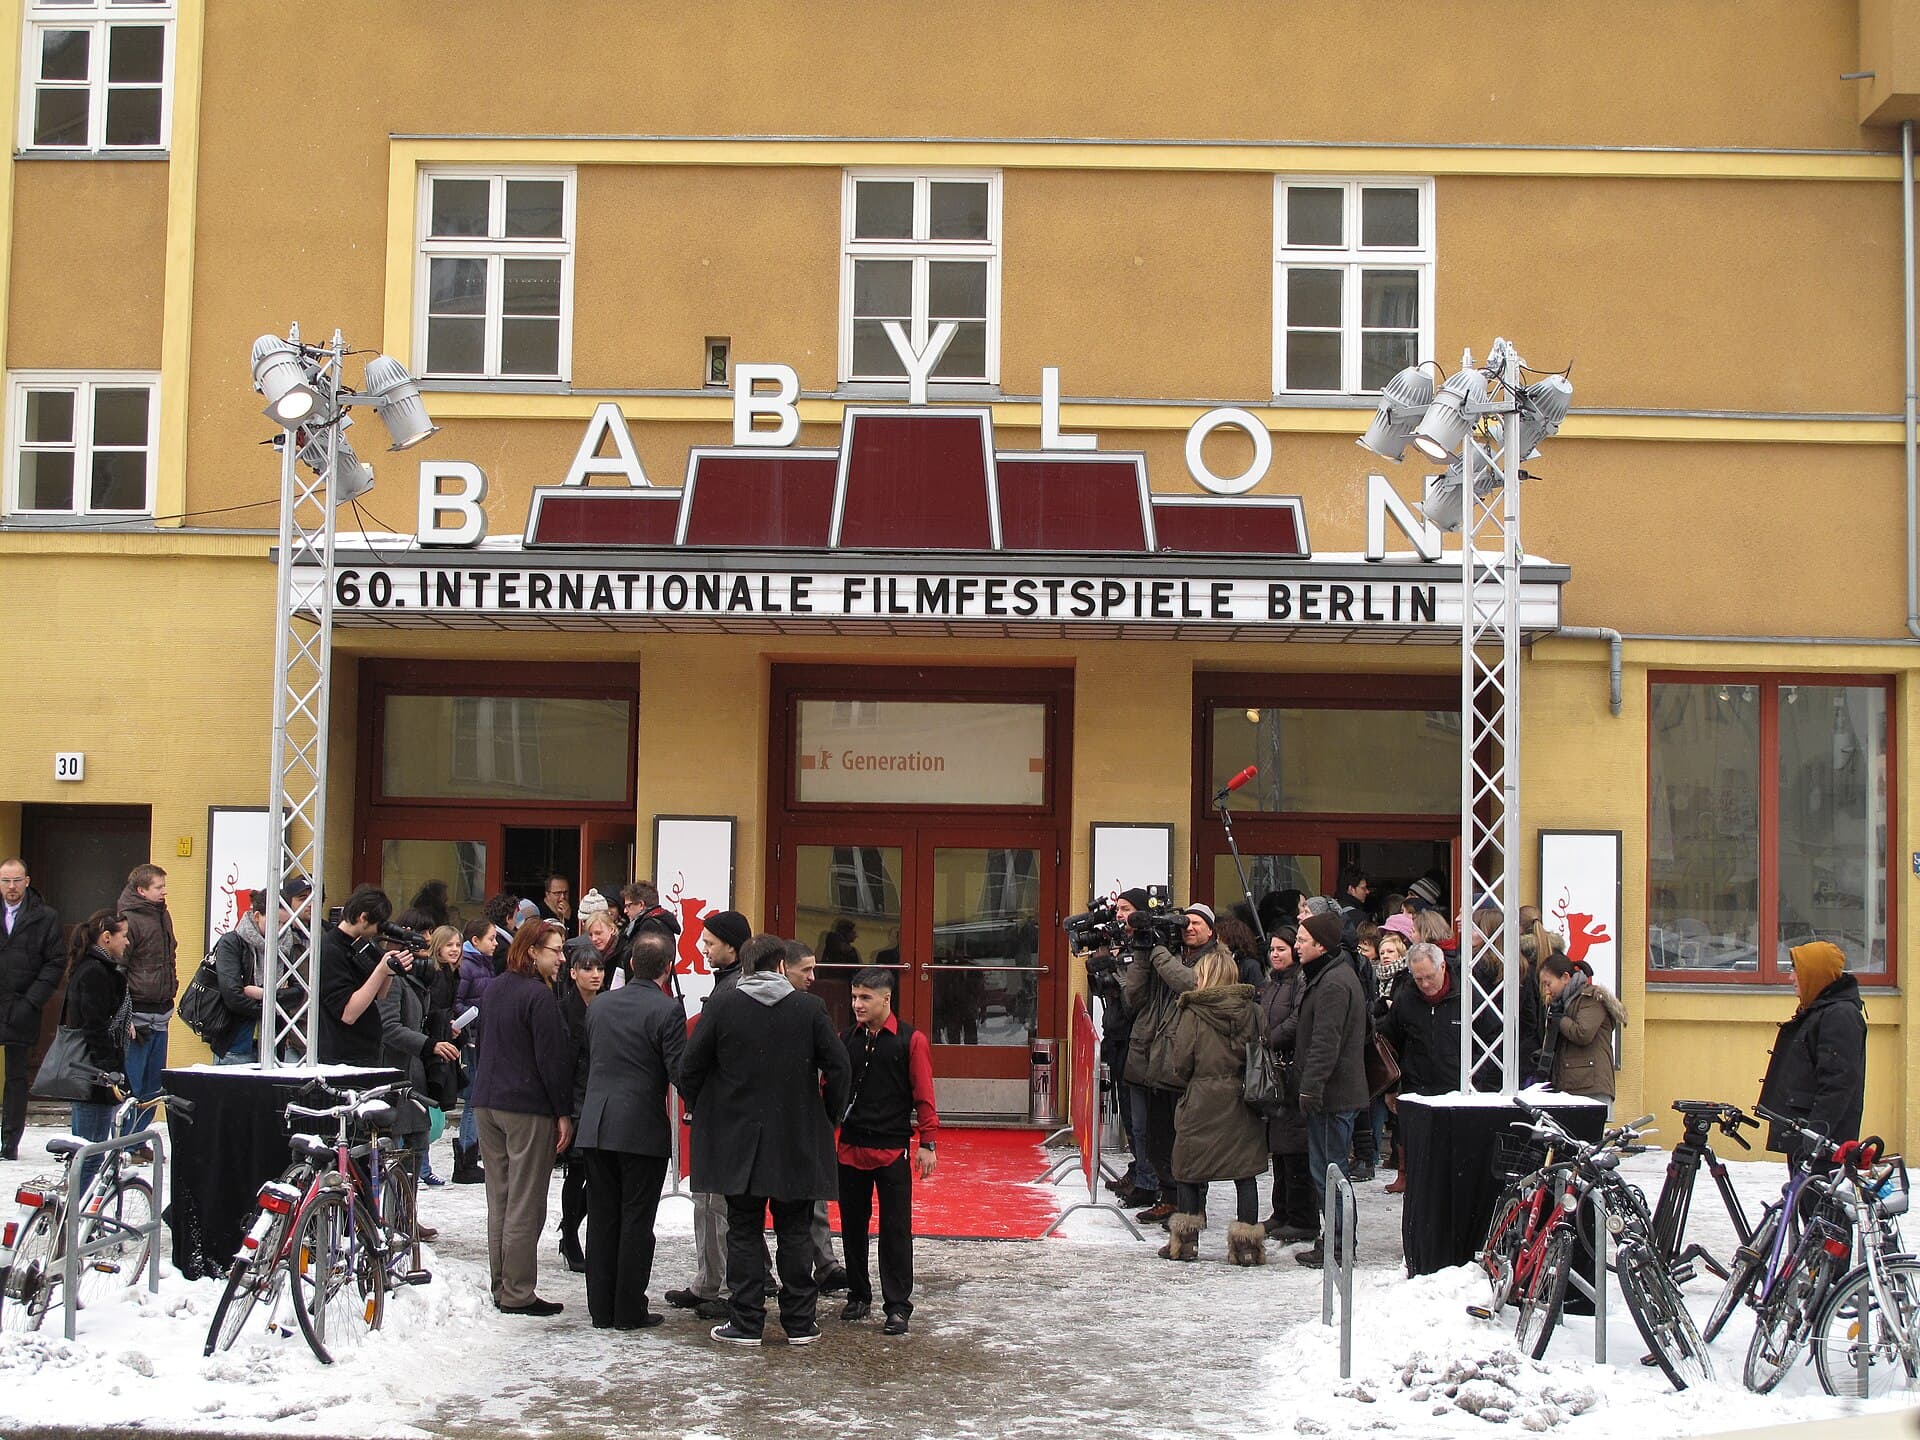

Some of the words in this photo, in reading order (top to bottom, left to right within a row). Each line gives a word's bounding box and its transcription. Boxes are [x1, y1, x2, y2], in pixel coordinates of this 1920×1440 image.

[416, 320, 1443, 562] BABYLON
[419, 570, 813, 613] INTERNATIONALE
[842, 577, 1235, 618] FILMFESTSPIELE
[1266, 583, 1438, 623] BERLIN
[58, 757, 78, 775] 30
[842, 750, 945, 772] Generation
